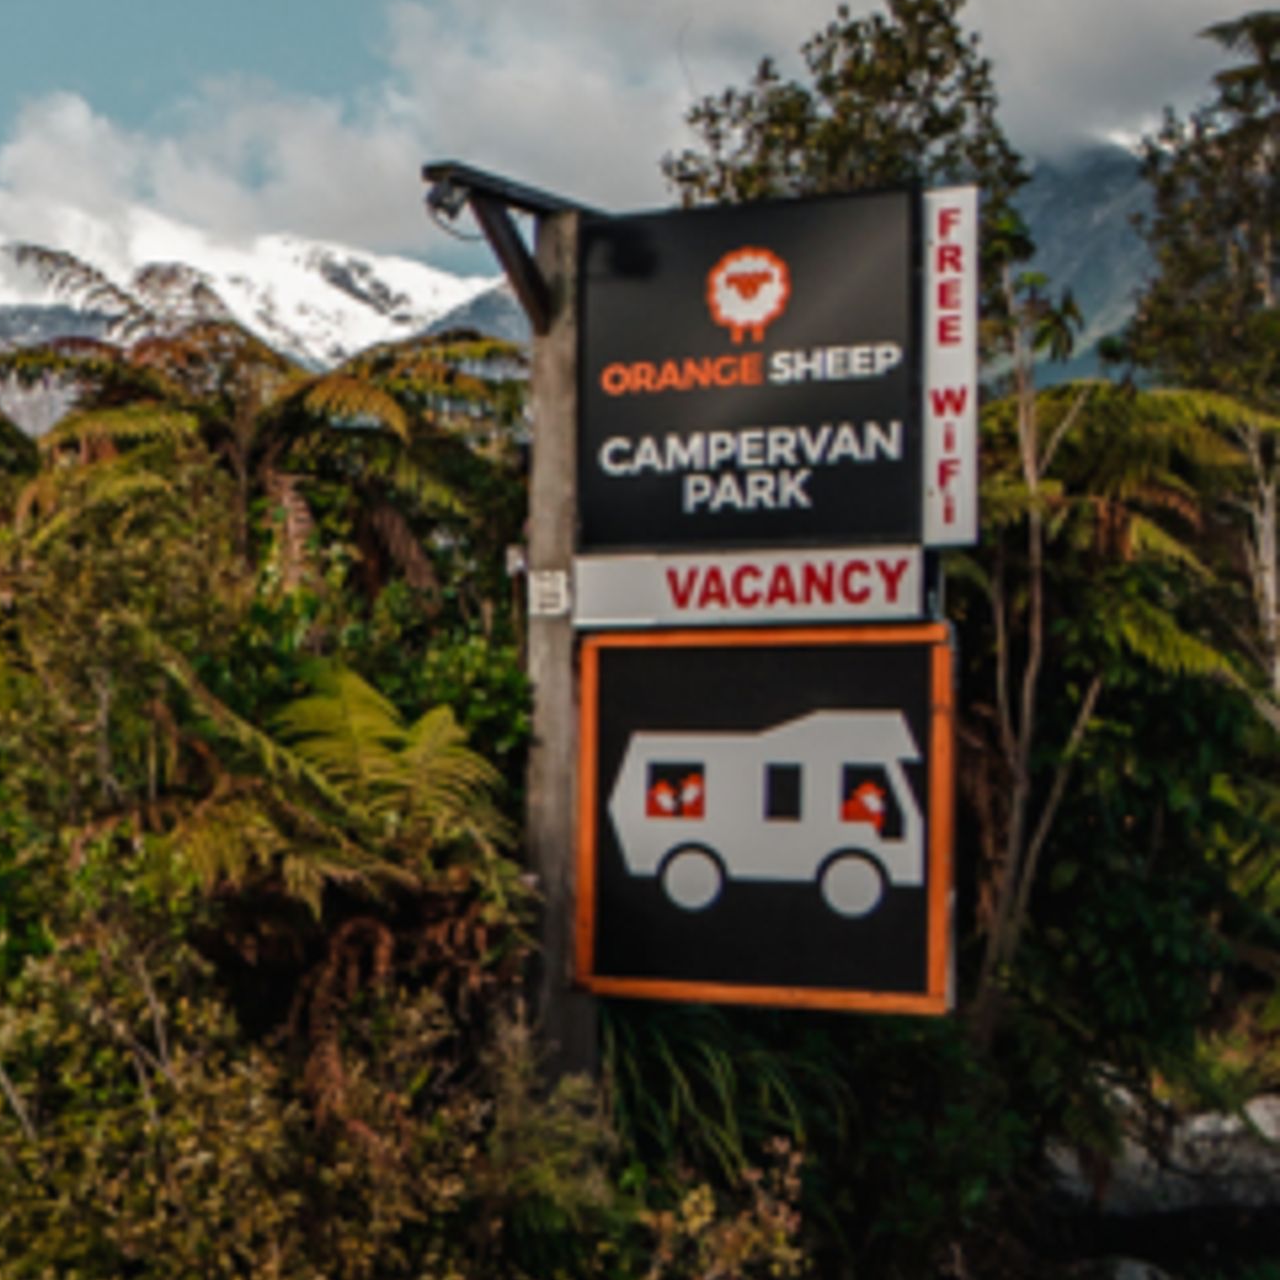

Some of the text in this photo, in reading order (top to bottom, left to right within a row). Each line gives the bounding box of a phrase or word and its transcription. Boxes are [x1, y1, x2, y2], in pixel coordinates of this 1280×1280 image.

[938, 208, 961, 345] FREE
[600, 343, 903, 395] ORANGE SHEEP
[598, 421, 903, 474] CAMPERVAN
[683, 470, 813, 513] PARK
[666, 558, 909, 610] VACANCY
